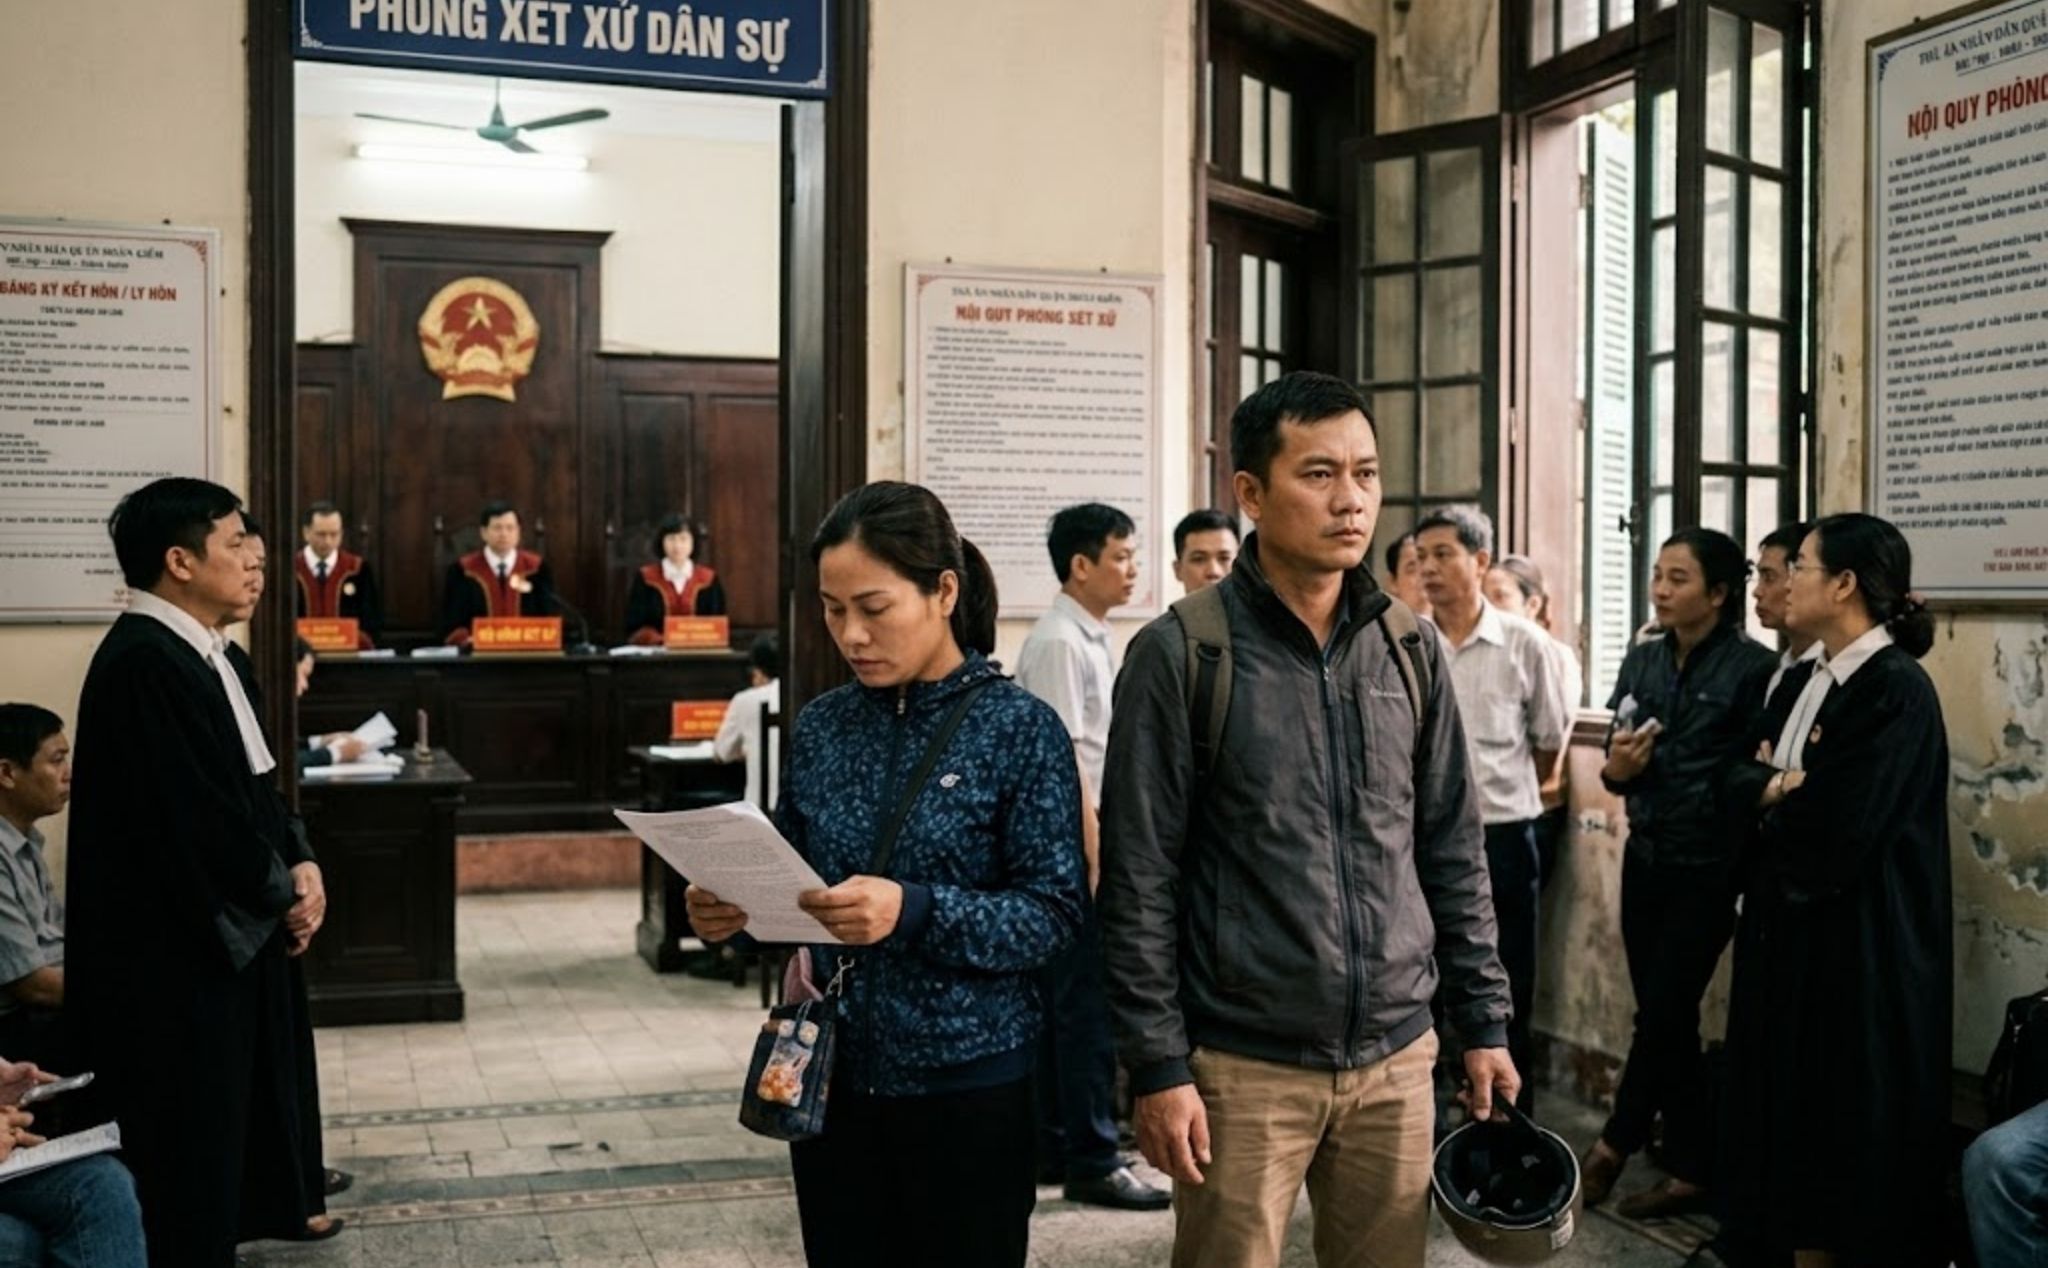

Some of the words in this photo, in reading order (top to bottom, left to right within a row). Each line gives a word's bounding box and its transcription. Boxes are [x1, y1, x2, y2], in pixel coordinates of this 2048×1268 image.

[647, 3, 725, 60] DÂN
[735, 17, 791, 74] SỰ
[1944, 94, 1981, 130] QUY
